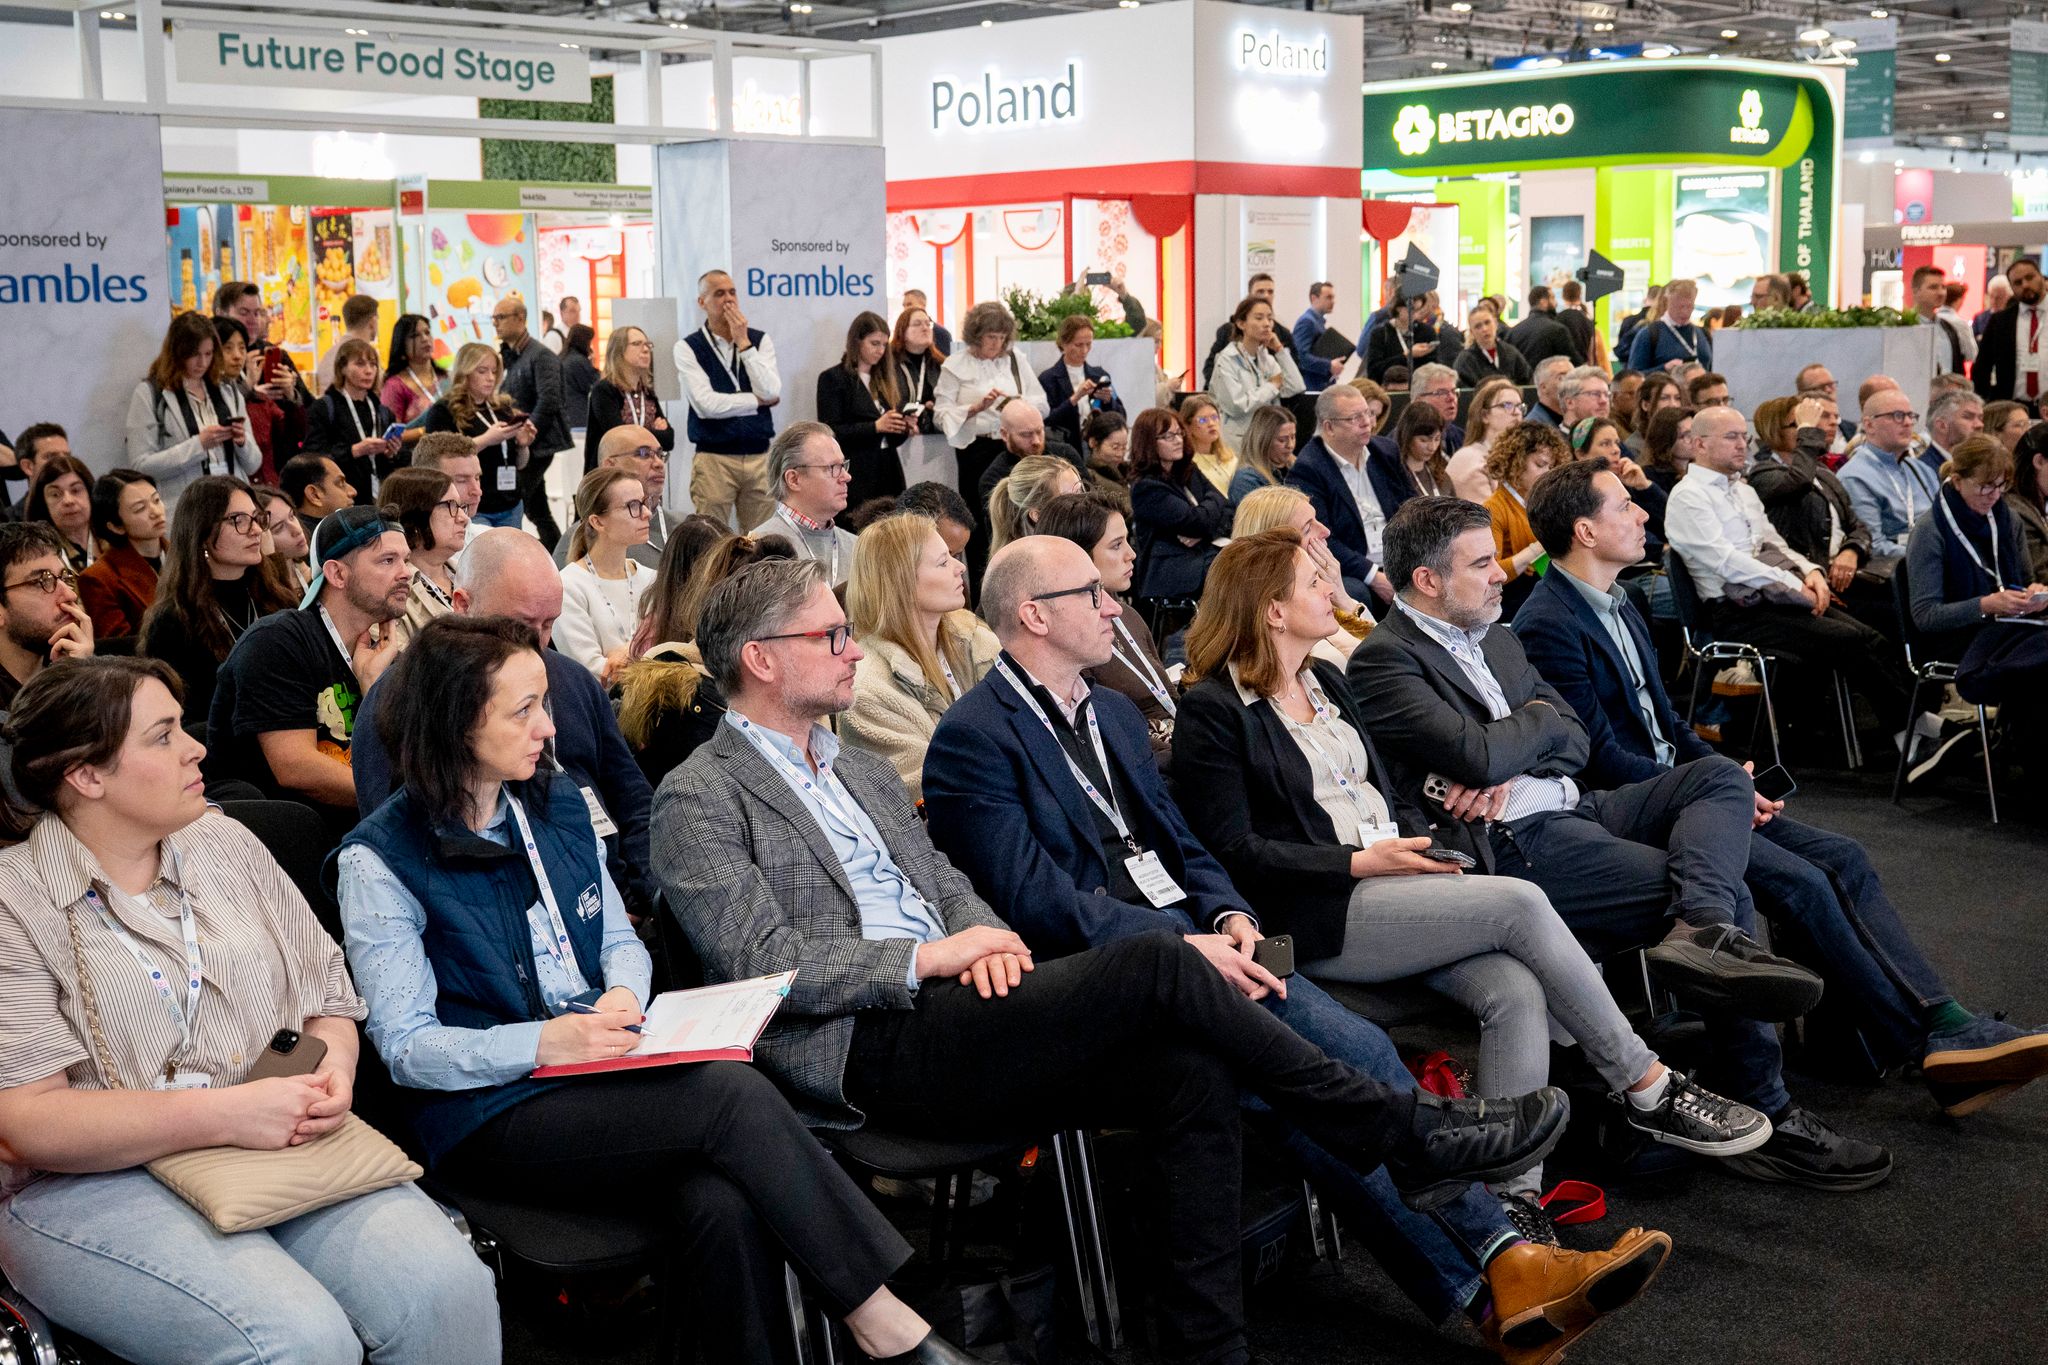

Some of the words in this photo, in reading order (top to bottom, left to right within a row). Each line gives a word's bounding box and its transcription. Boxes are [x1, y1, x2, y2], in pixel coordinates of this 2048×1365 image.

[218, 33, 345, 73] Future
[355, 42, 444, 79] Food
[455, 48, 555, 91] Stage
[1242, 33, 1326, 70] Poland
[933, 63, 1075, 128] Poland
[1438, 103, 1574, 144] BETAGRO
[197, 185, 217, 194] Food
[237, 186, 254, 195] LTD
[610, 192, 628, 200] Import
[1798, 158, 1814, 239] THAILAND
[0, 232, 80, 248] ponsored
[86, 232, 107, 251] by
[771, 239, 833, 255] Sponsored
[836, 240, 850, 255] by
[1797, 243, 1811, 267] OF
[0, 263, 148, 303] ambles
[747, 264, 874, 297] Brambles
